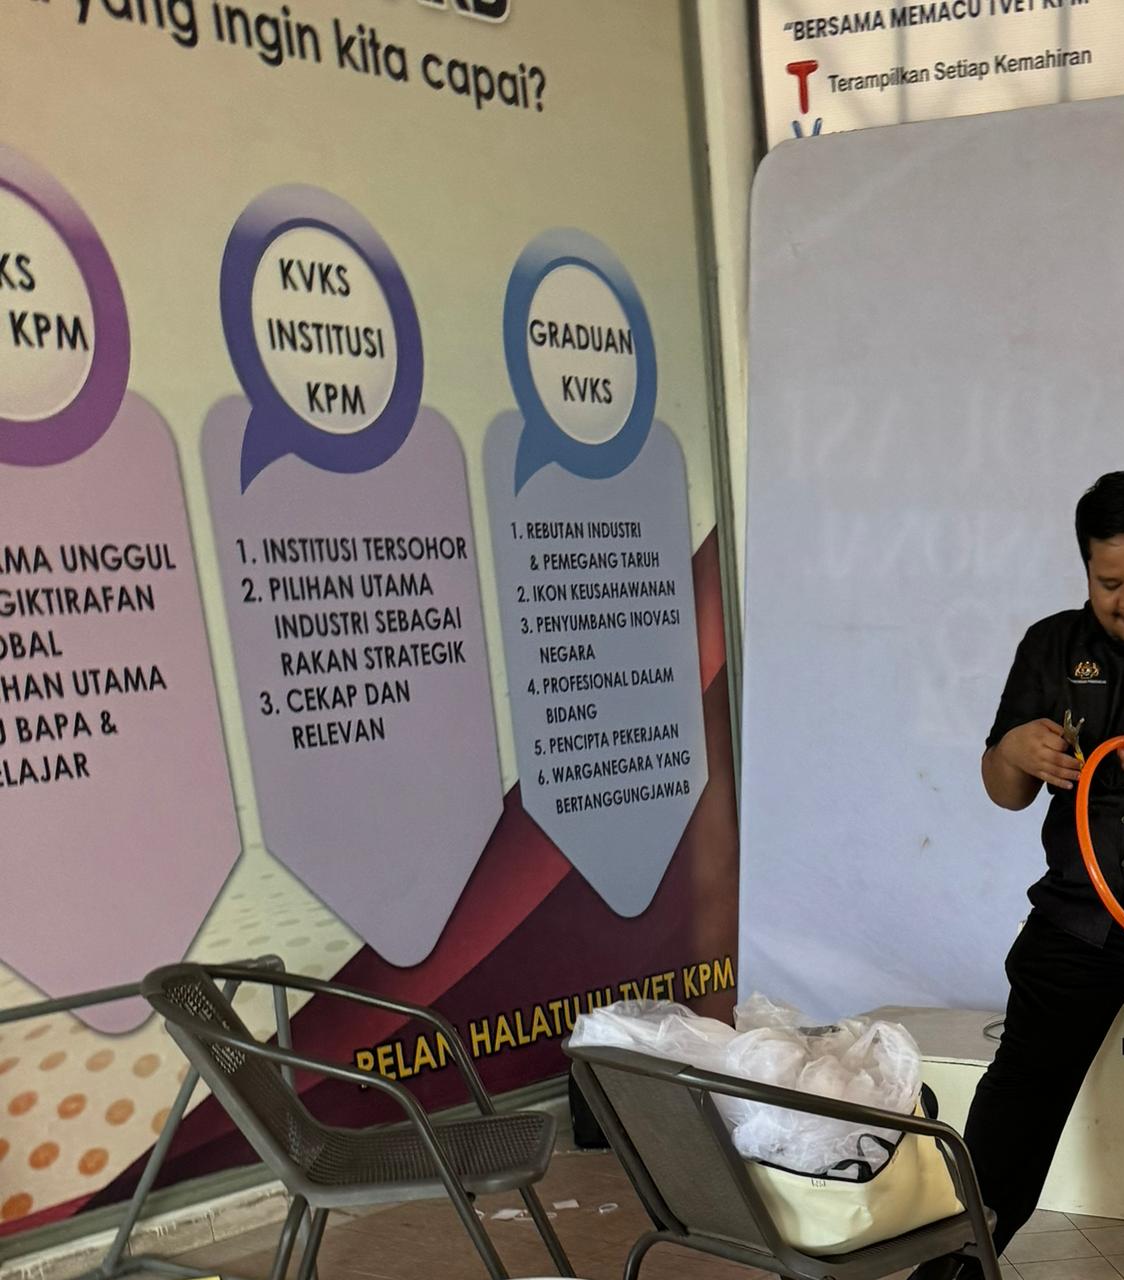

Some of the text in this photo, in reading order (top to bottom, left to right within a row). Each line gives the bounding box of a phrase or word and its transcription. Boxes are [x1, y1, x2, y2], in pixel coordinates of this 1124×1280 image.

[890, 0, 981, 29] MEMACU
[334, 18, 408, 83] kita
[421, 53, 547, 112] capai?
[827, 48, 1093, 94] Terampilkan Setiap Kemahiran
[785, 59, 819, 115] T
[279, 258, 350, 296] KVKS
[9, 311, 89, 351] KPM
[268, 318, 384, 358] INSTITUSI
[530, 318, 634, 356] GRADUAN
[307, 382, 365, 415] KPM
[562, 376, 612, 404] KVKS
[511, 522, 641, 539] 1. REBUTAN INDUSTRI
[0, 544, 176, 574] MA UNGGUL
[236, 537, 467, 564] 1. INSTITUSI TERSOHOR
[531, 552, 659, 570] & PEMEGANG TARUH
[242, 573, 433, 602] 2. PILIHAN UTAMA
[517, 581, 675, 602] 2. IKON KEUSAHAWANAN
[275, 607, 461, 639] INDUSTRI SEBAGAI
[521, 610, 679, 634] 3. PENYUMBANG INOVASI
[281, 641, 465, 676] RAKAN STRATEGIK
[540, 644, 595, 663] NEGARA
[72, 666, 167, 696] UTAMA
[528, 667, 673, 695] 4. PROFESIONAL DALAM
[260, 680, 410, 715] 3. CEKAP DAN
[16, 712, 92, 743] BAPA
[101, 711, 117, 735] &
[546, 704, 597, 724] BIDANG
[292, 717, 384, 749] RELEVAN
[535, 724, 678, 756] 5. PENCIPTA PEKERJAAN
[0, 752, 90, 787] LAJAR
[538, 750, 690, 785] 6. WARGANEGARA YANG
[556, 780, 689, 814] BERTANGGUNGJAWAB
[683, 957, 735, 1000] KPM
